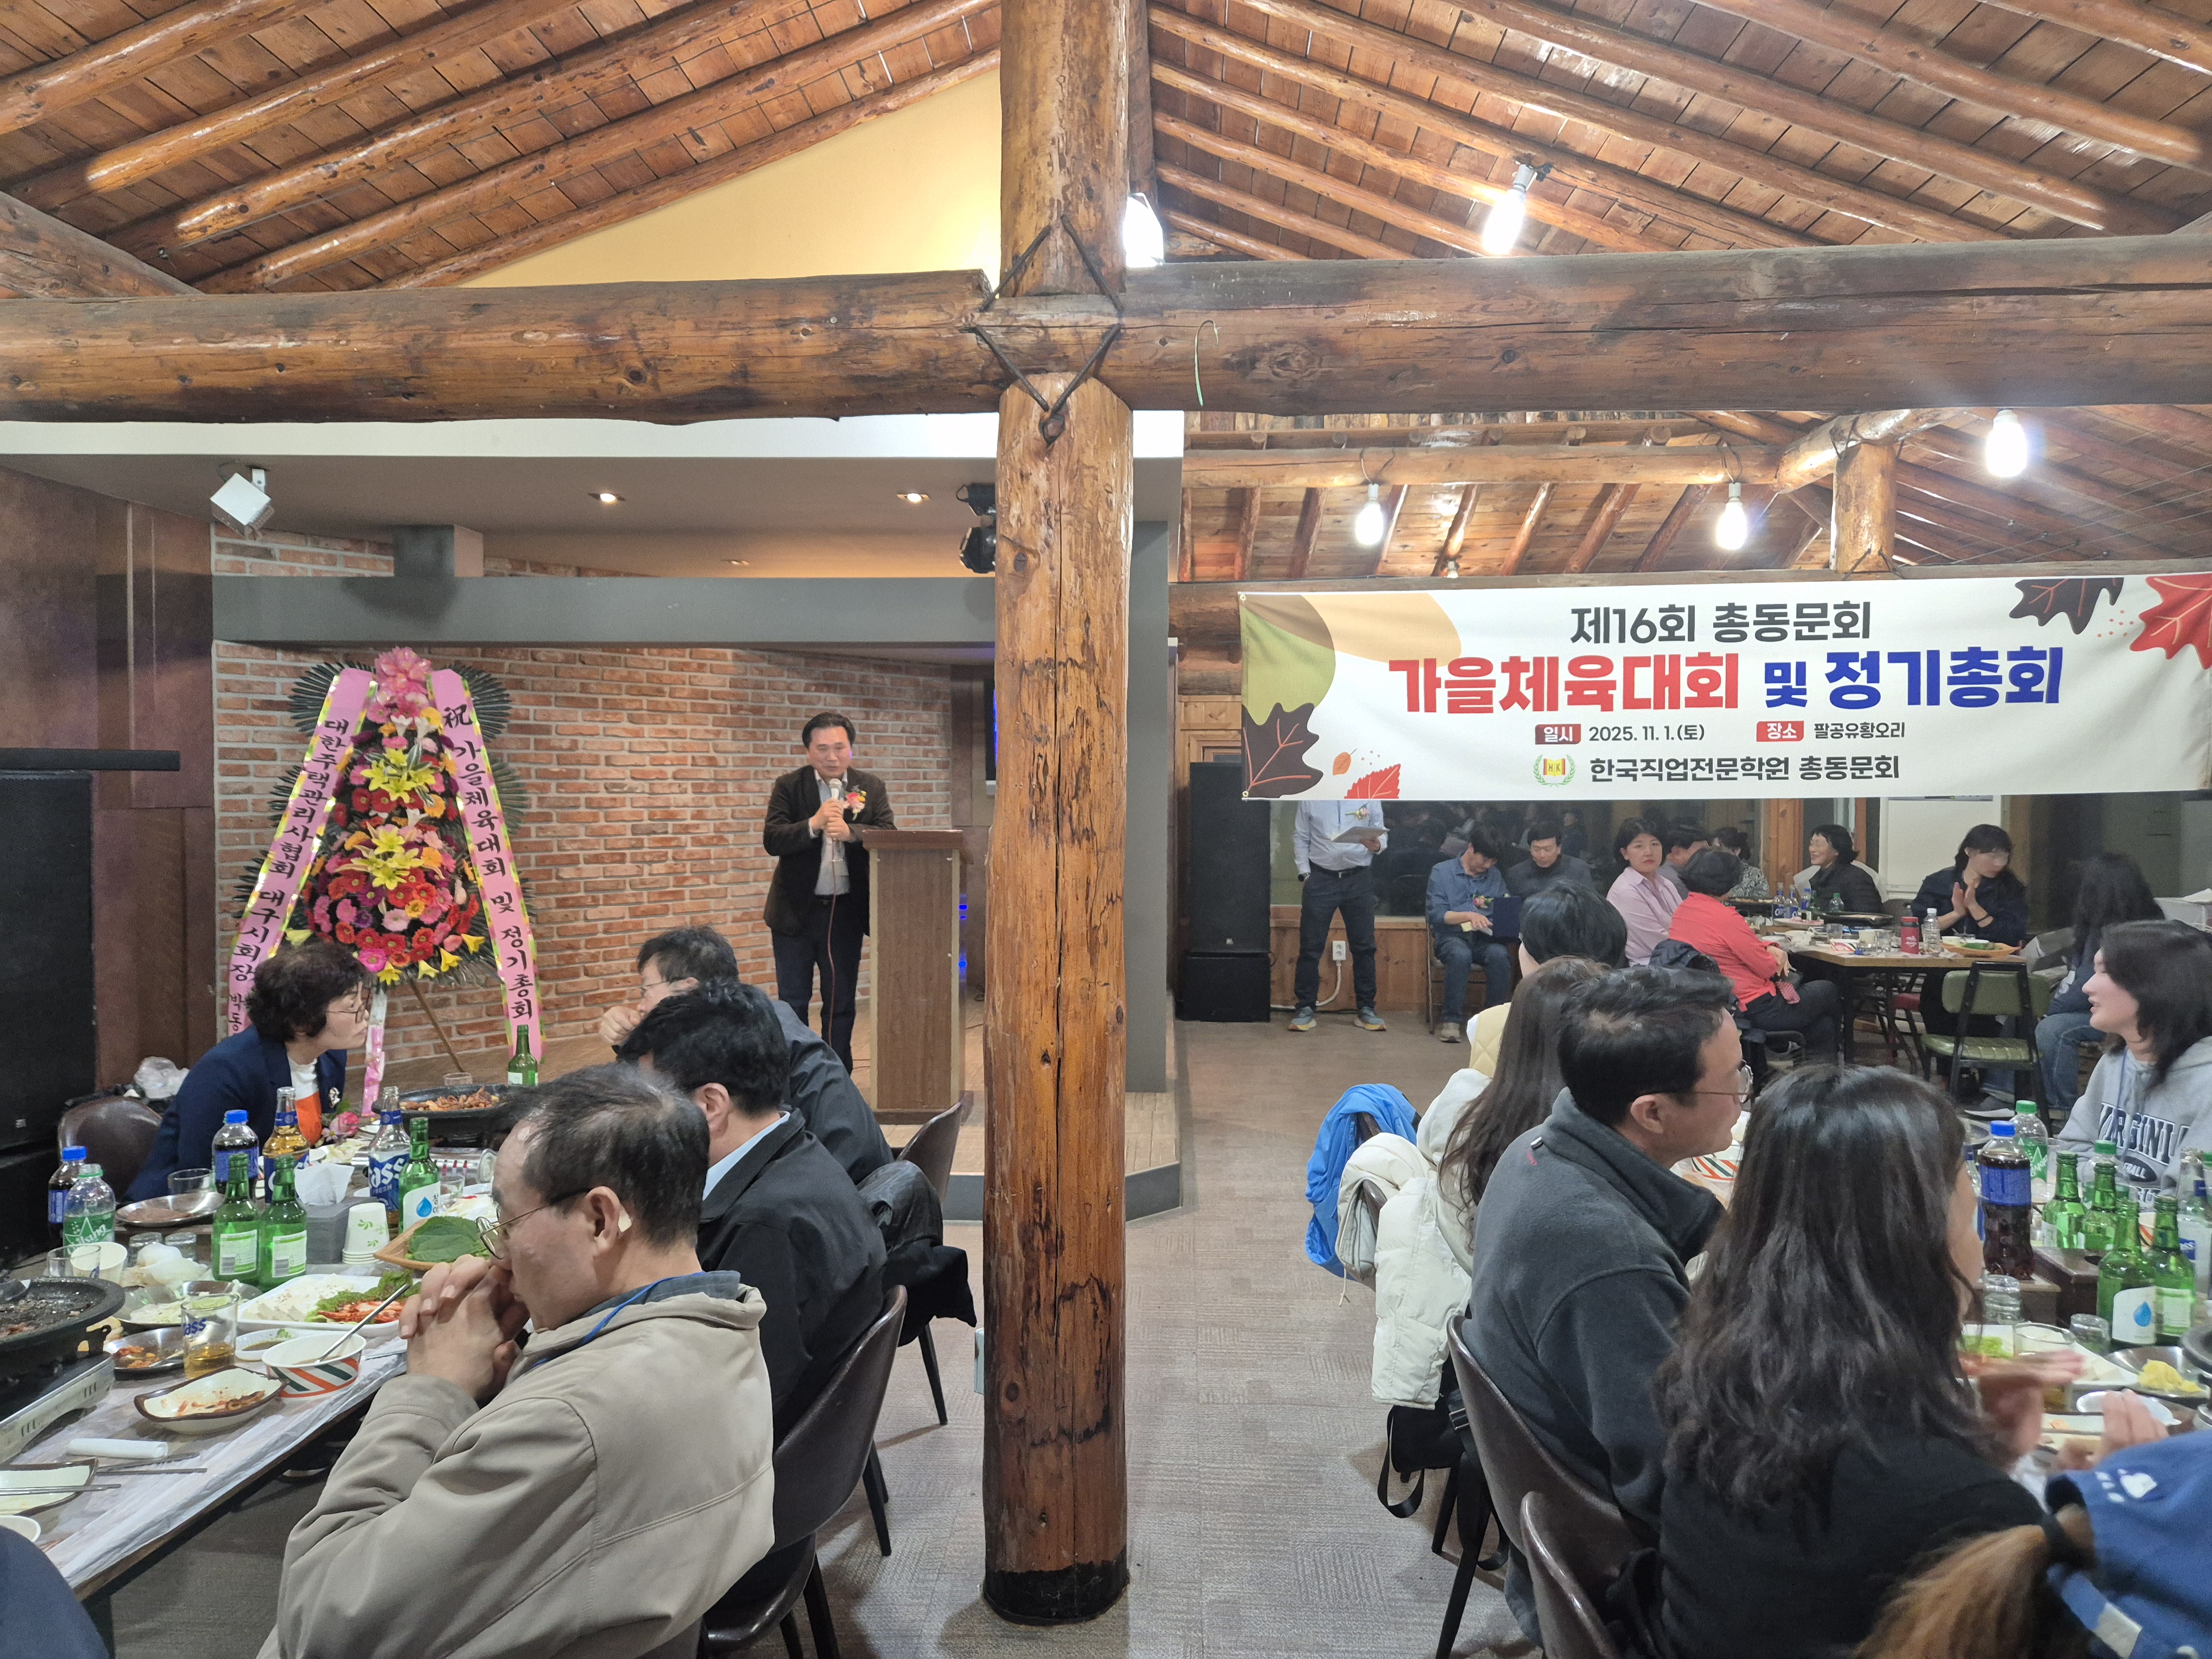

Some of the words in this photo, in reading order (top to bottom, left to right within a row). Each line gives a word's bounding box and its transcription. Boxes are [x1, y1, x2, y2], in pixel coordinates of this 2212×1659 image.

[1571, 604, 1695, 644] 제16회
[1713, 601, 1871, 644] 총동문회
[1389, 651, 1739, 714] 가을체육대회
[1765, 661, 1808, 708] 및
[1825, 646, 2064, 710] 정기총회
[442, 703, 473, 729] 祝
[1543, 726, 1573, 743] 일시
[1589, 726, 1638, 742] 2025.
[1642, 726, 1660, 741] 11.
[1767, 723, 1798, 740] 장소
[1814, 722, 1906, 740] 팔공유황오리
[1590, 757, 1790, 782] 한국직업전문학원
[1799, 755, 1900, 781] 총동문회
[268, 718, 349, 879] 대한주택관리사협회
[452, 740, 507, 878] 가을체육대회
[489, 891, 515, 914] 및
[229, 889, 286, 982] 대구시회장
[500, 925, 534, 1020] 정기총회
